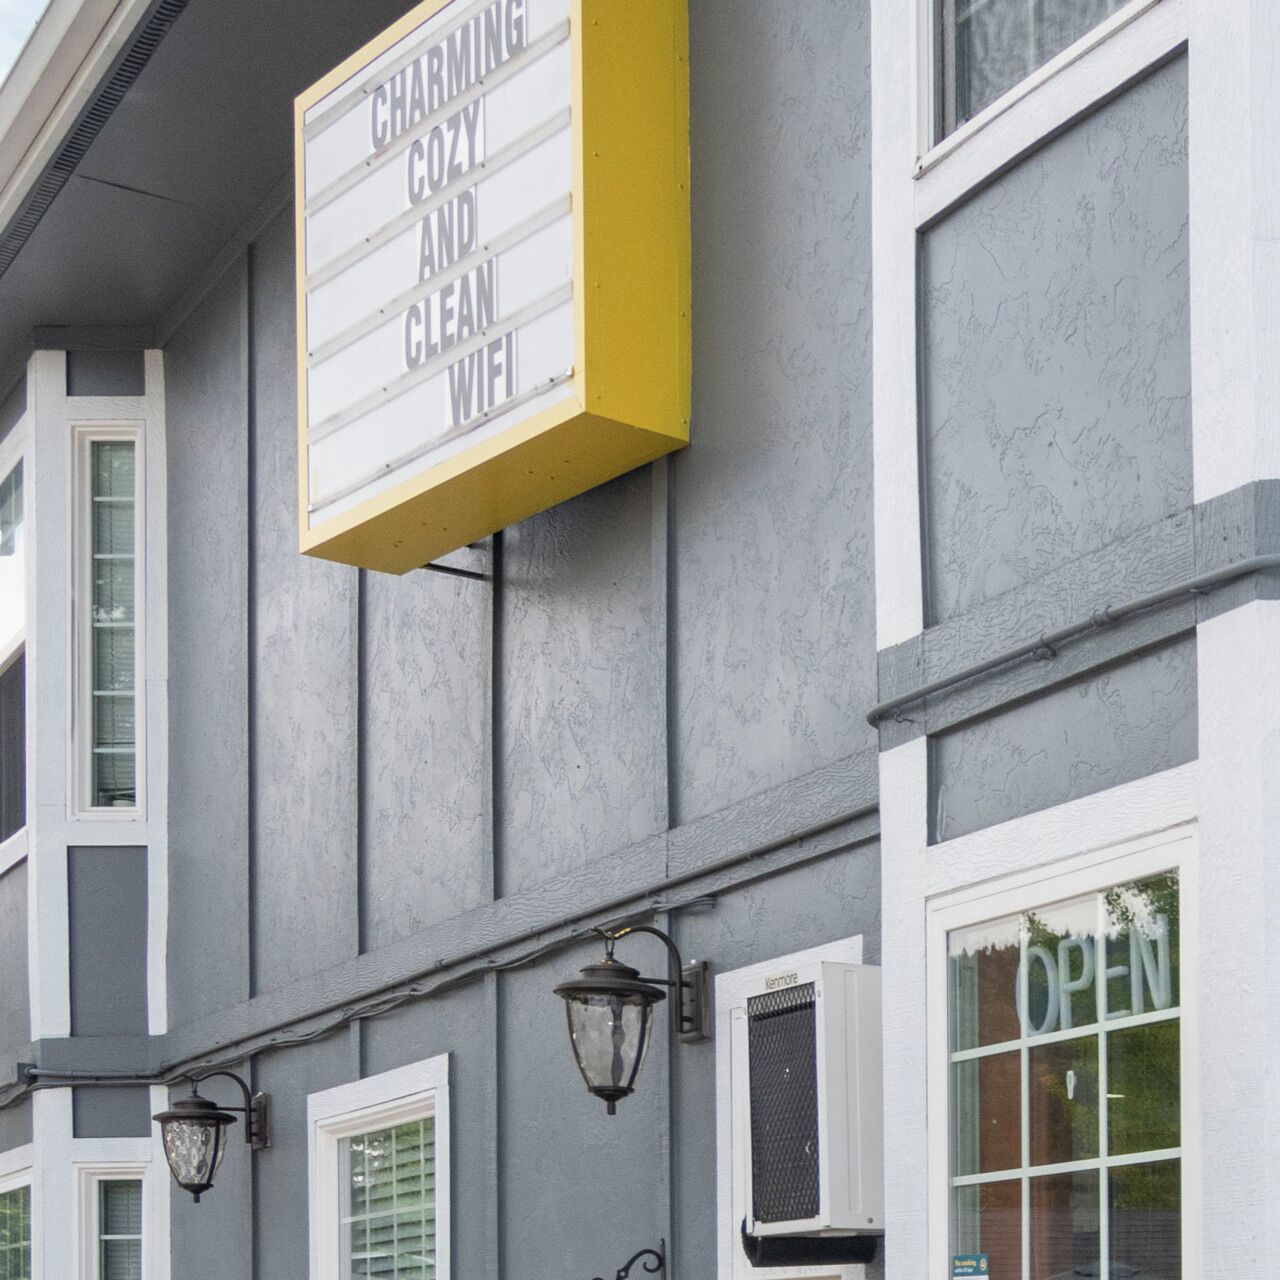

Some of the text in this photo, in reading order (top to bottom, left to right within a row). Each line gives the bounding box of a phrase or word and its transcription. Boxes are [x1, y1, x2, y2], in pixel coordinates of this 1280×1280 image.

[371, 0, 524, 151] CHARMING
[408, 97, 481, 207] COZY
[419, 190, 475, 286] AND
[404, 258, 494, 370] CLEAN
[448, 331, 514, 426] WIFI
[765, 972, 799, 991] Kenmore
[1016, 913, 1172, 1037] OPEN
